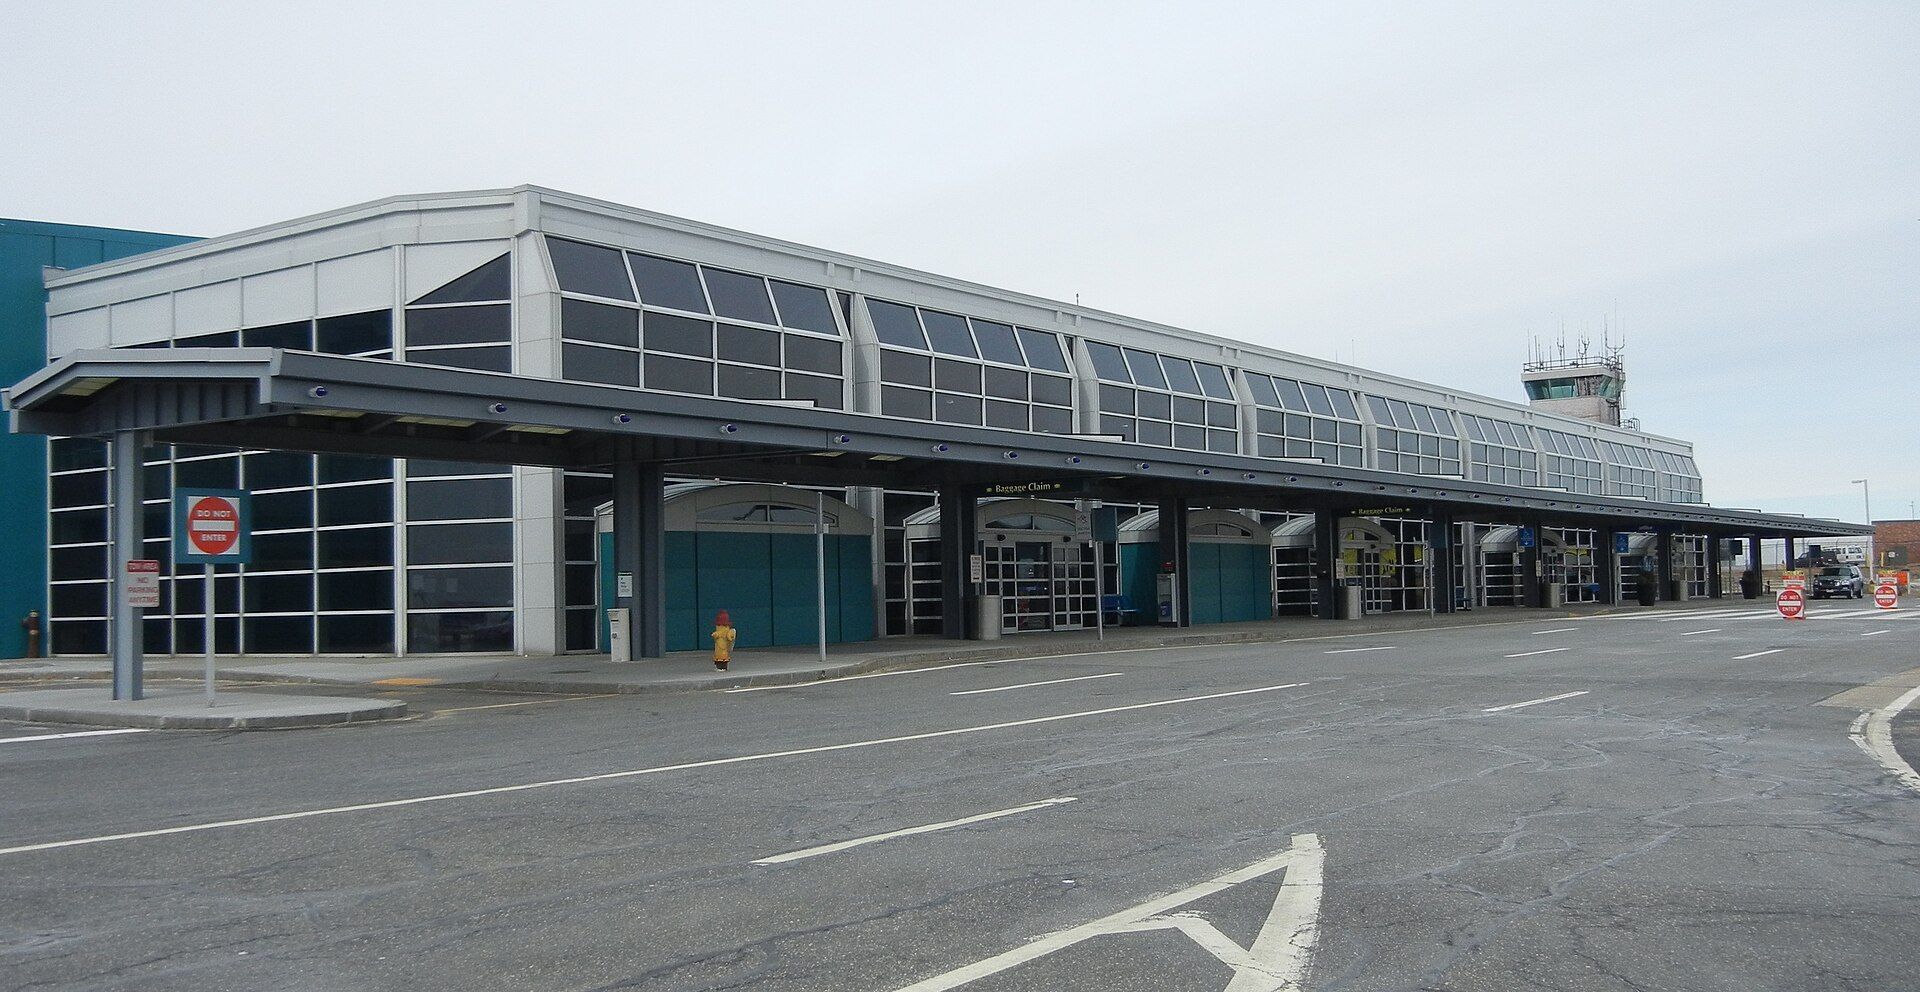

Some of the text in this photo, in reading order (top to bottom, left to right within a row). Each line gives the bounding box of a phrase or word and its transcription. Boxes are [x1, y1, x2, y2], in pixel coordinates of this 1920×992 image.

[995, 481, 1051, 493] Baggage Claim
[213, 510, 231, 518] NOT
[201, 533, 227, 541] ENTER
